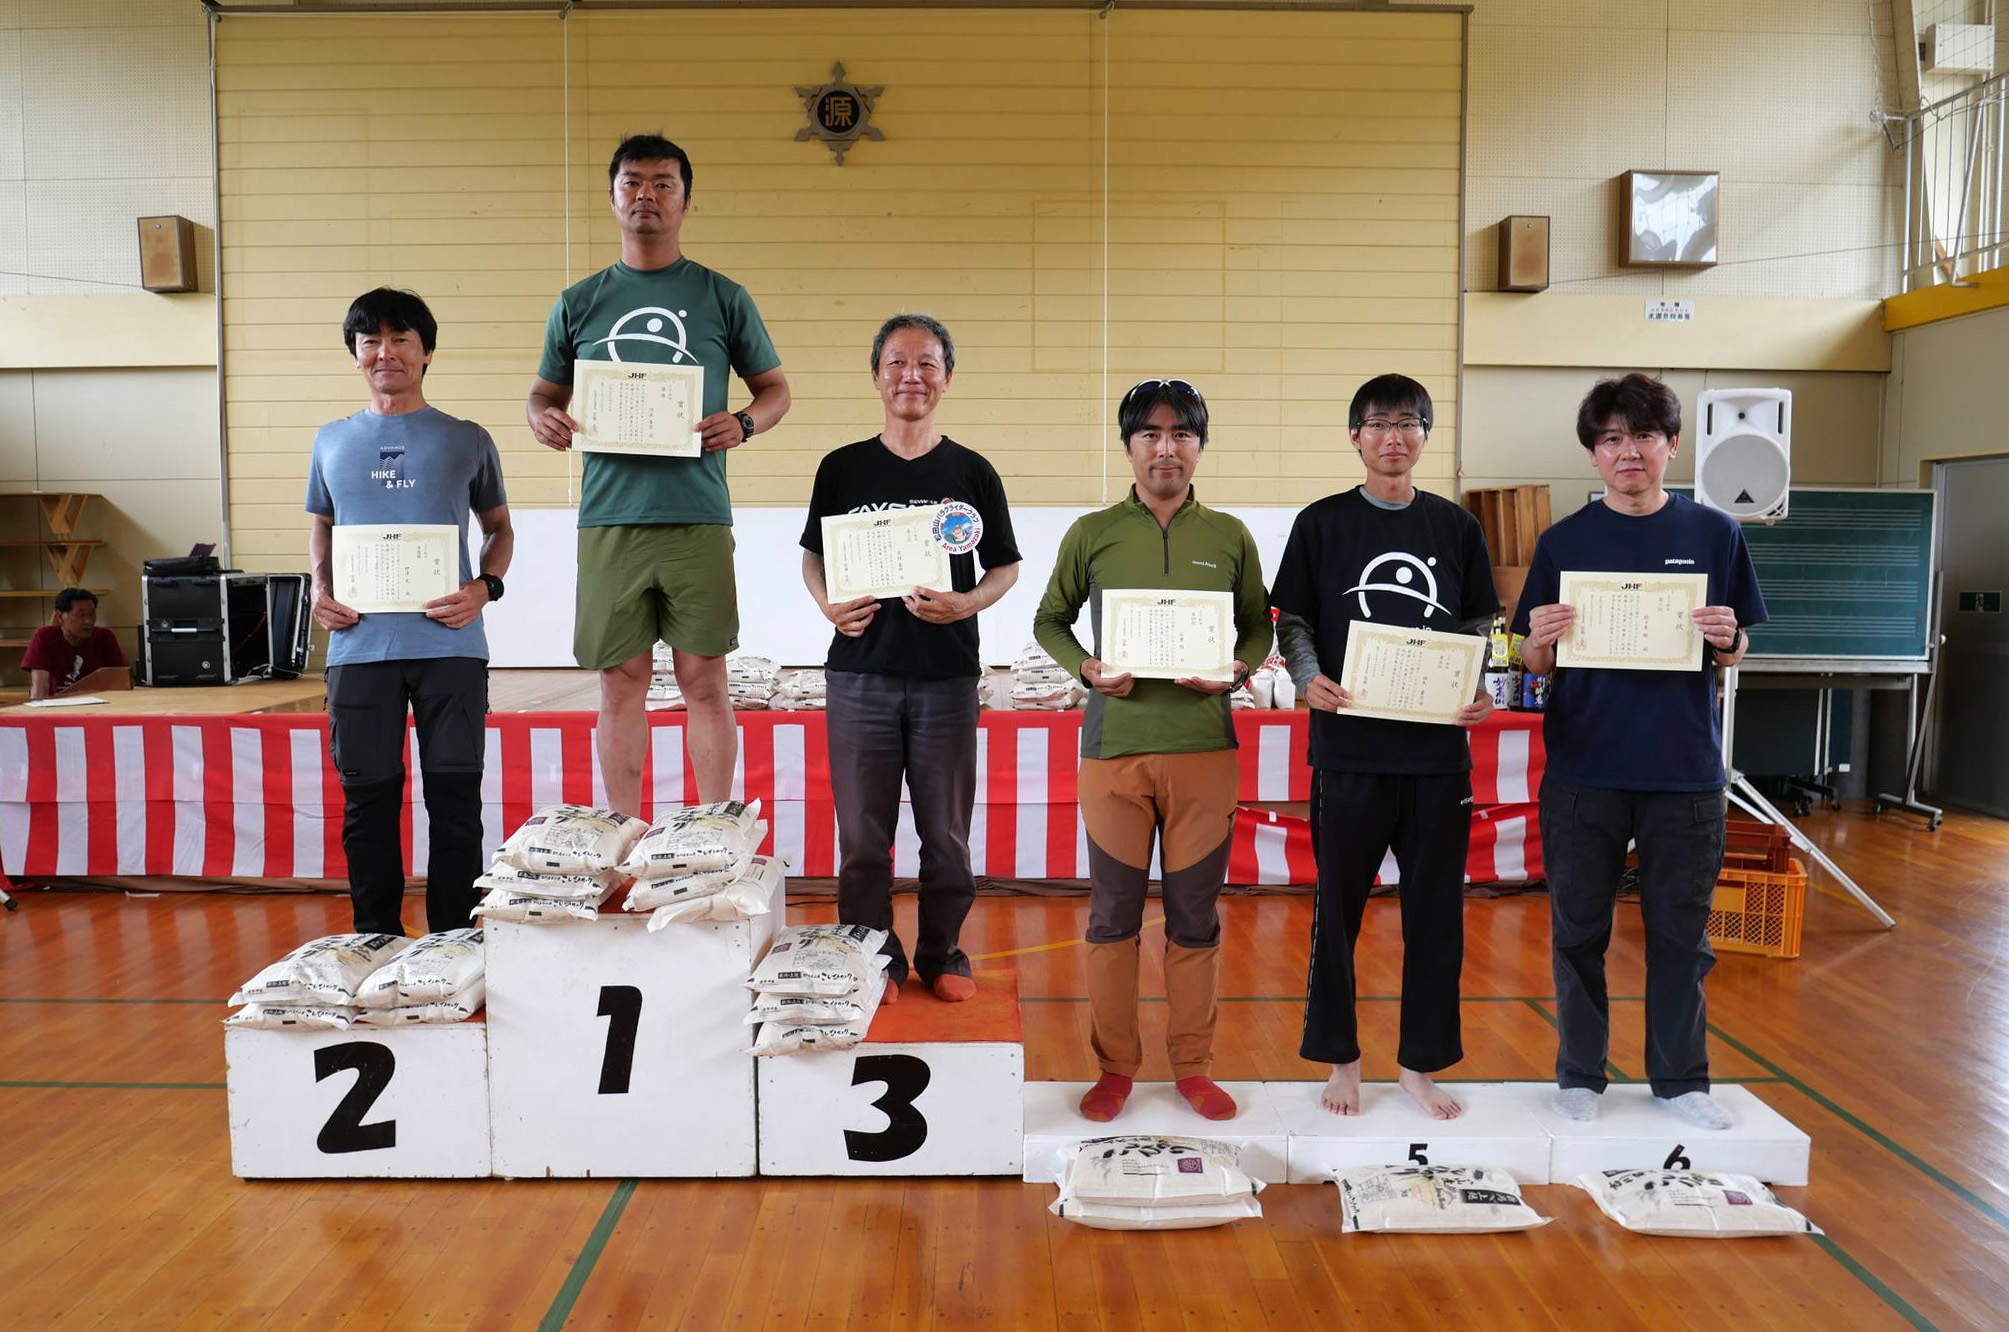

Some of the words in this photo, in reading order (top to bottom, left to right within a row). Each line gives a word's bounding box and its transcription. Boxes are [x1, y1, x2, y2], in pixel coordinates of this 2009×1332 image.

[825, 97, 852, 127] 源
[371, 470, 396, 479] HIKE
[386, 480, 394, 489] &
[396, 479, 416, 488] FLY
[873, 519, 891, 527] JHF
[942, 543, 957, 552] Area
[959, 527, 981, 552] Yamazaki
[597, 985, 643, 1094] 1
[314, 1041, 396, 1154] 2
[843, 1054, 931, 1162] 3
[1408, 1143, 1428, 1165] 5
[1663, 1144, 1691, 1170] 6
